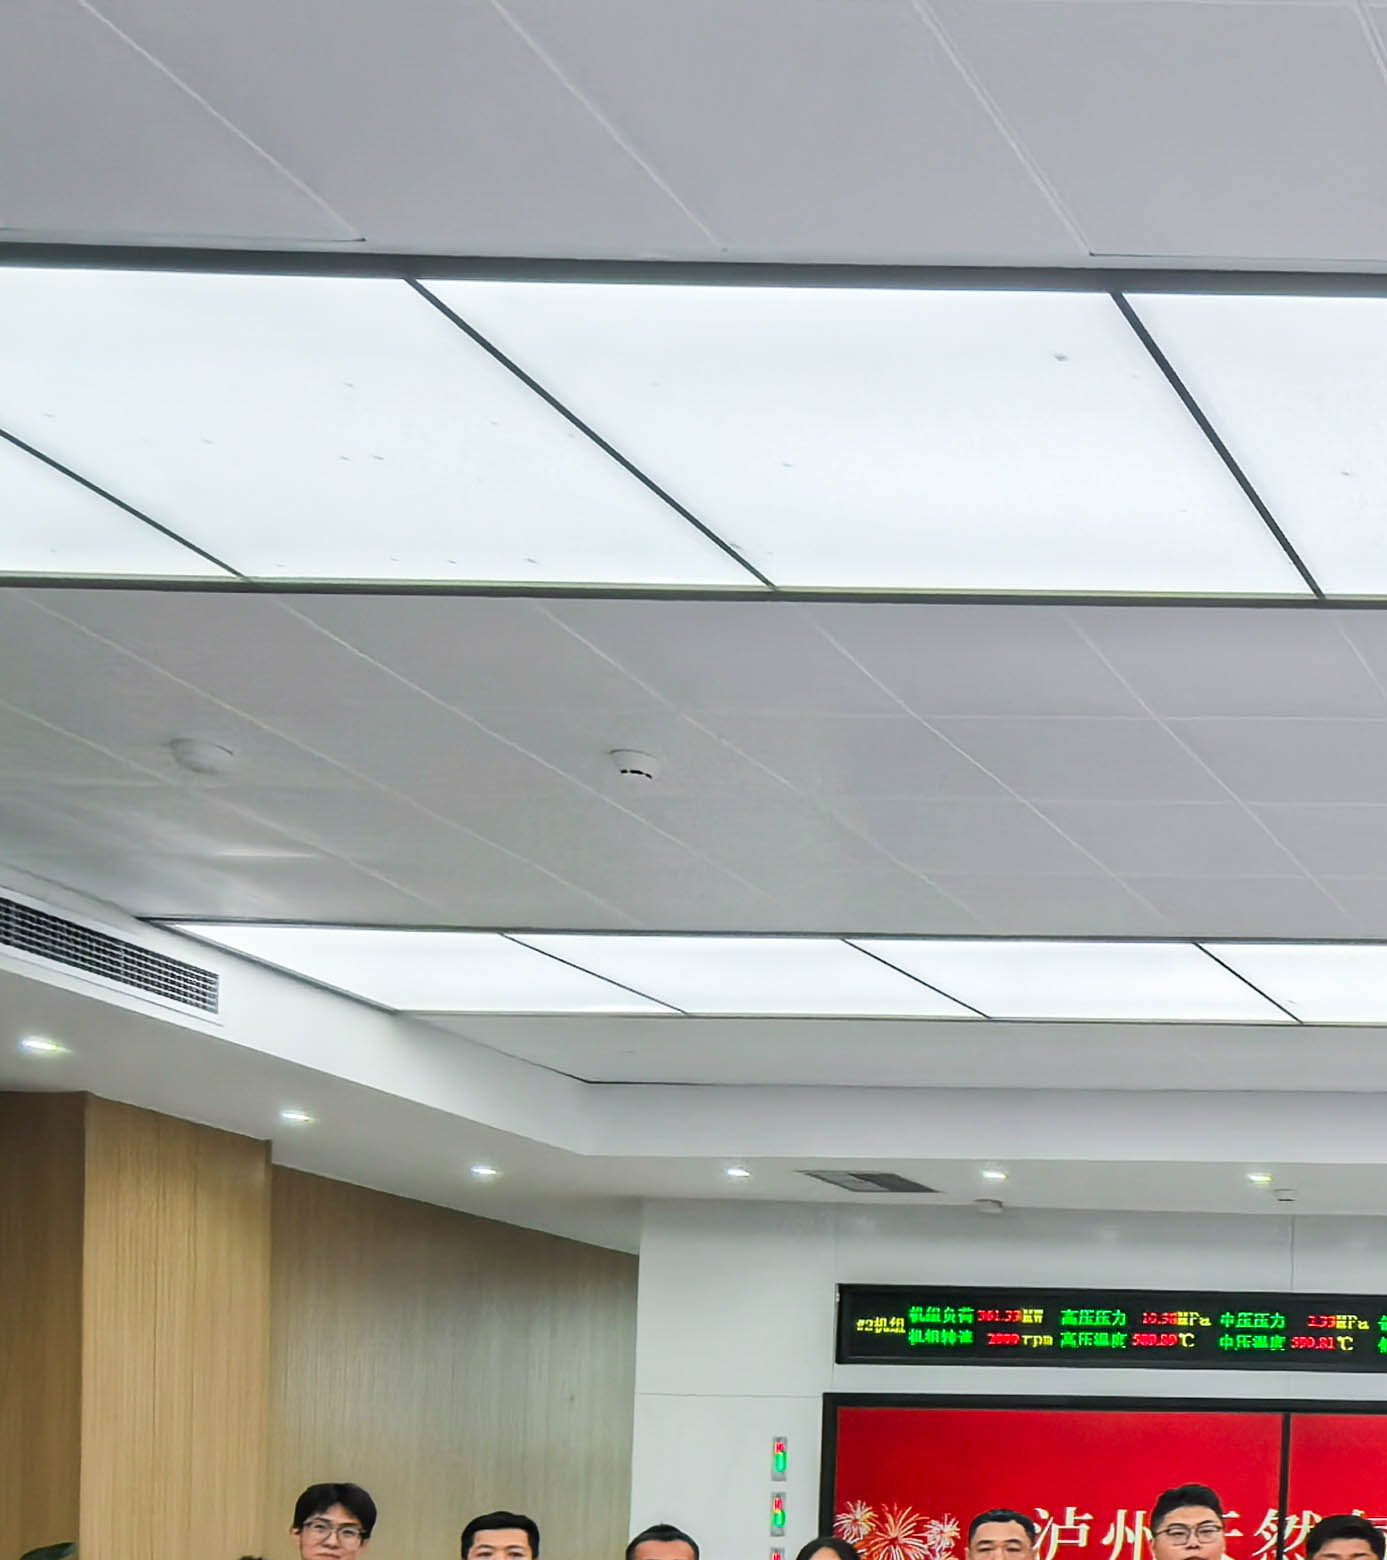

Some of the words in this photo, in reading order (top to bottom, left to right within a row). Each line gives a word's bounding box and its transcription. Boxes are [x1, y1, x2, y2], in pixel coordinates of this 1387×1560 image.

[1061, 1309, 1126, 1326] 高压压力
[1220, 1312, 1285, 1328] 中压压力
